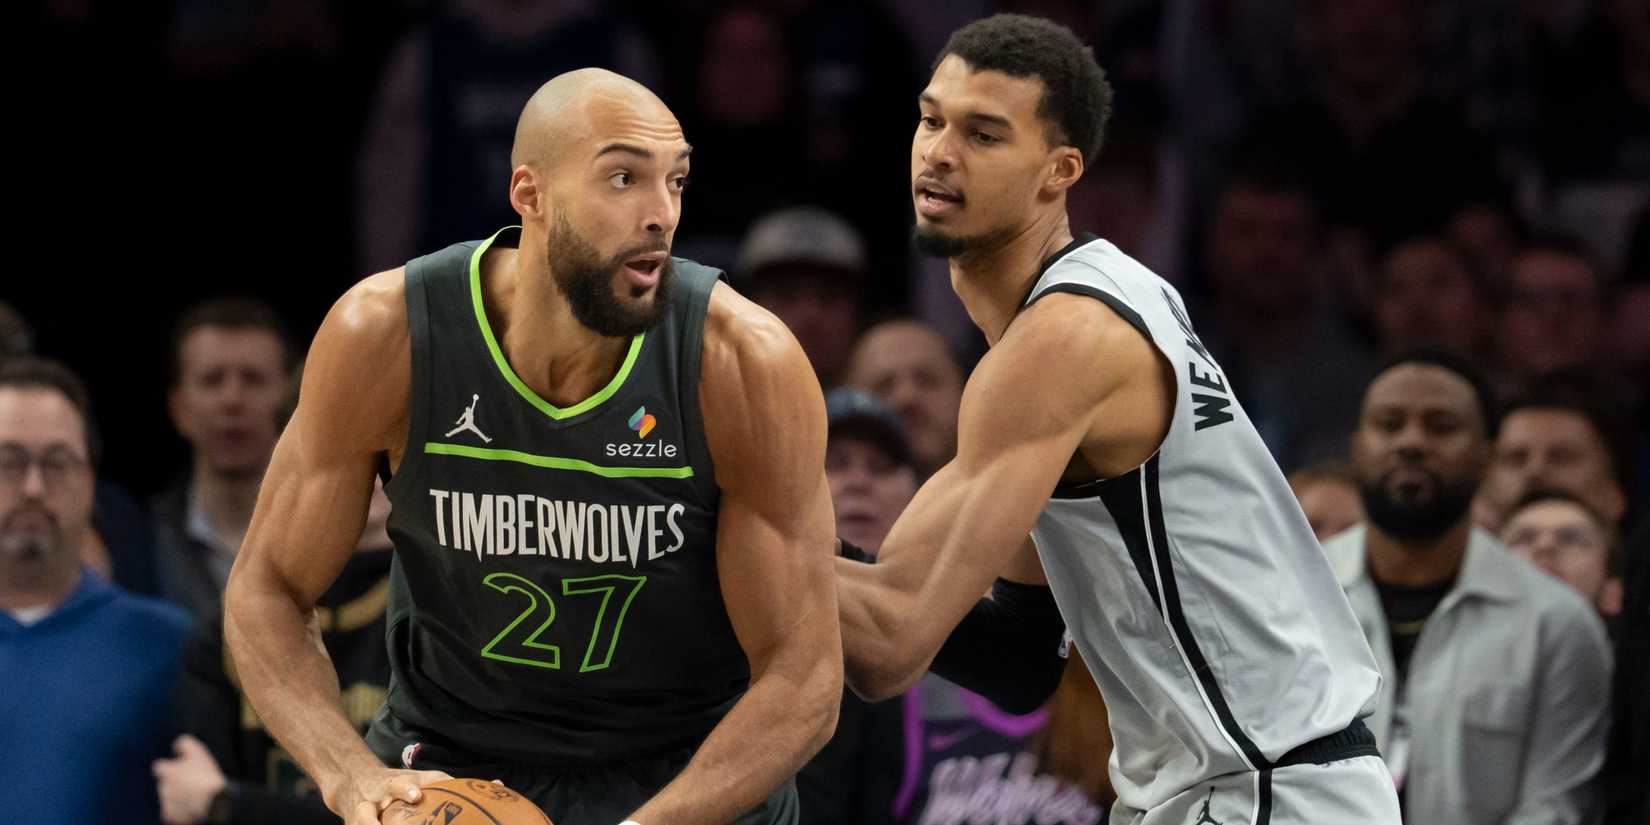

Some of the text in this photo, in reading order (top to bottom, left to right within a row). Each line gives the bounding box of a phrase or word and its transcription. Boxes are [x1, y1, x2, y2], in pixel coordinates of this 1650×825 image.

[605, 439, 678, 458] sezzle
[429, 488, 686, 569] TIMBERWOLVES
[480, 571, 648, 674] 27
